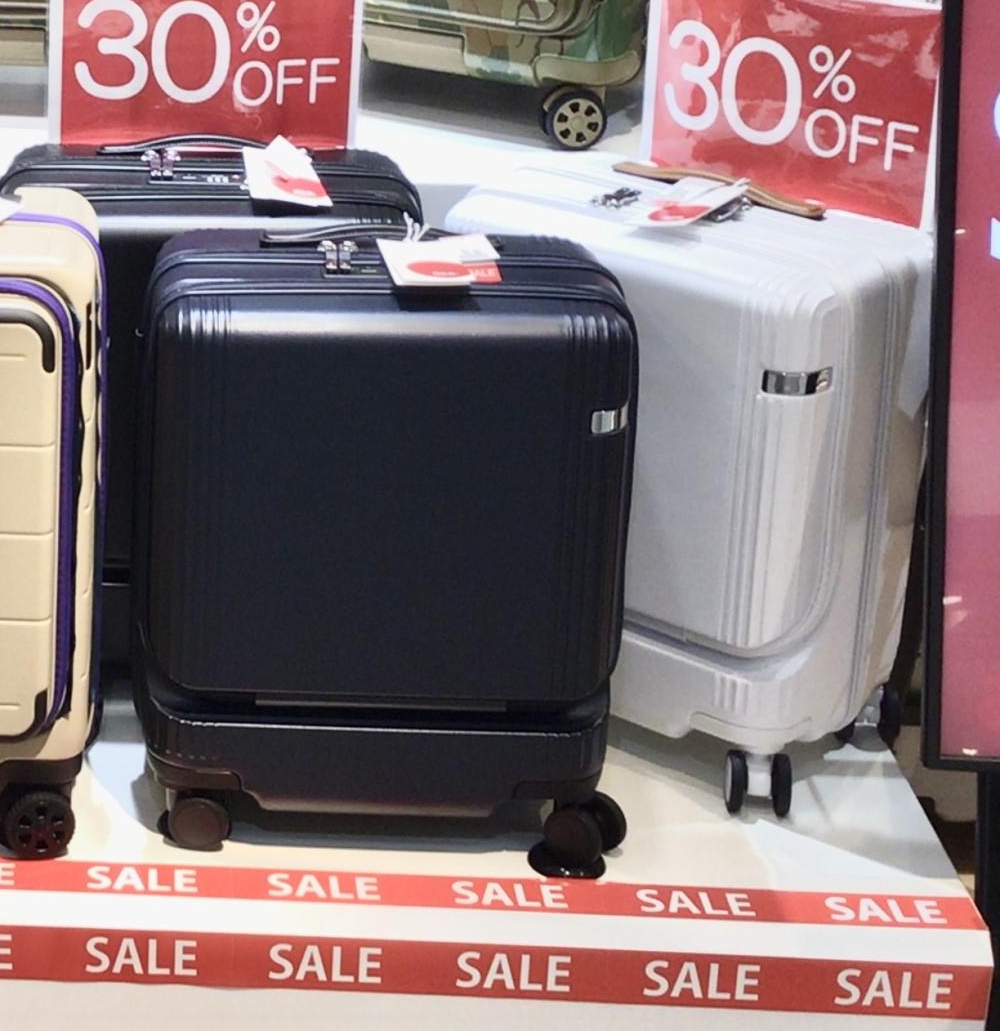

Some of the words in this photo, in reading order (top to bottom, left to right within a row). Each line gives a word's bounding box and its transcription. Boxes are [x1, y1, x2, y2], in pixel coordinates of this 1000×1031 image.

[233, 58, 340, 107] OFF
[805, 109, 919, 171] OFF
[86, 866, 198, 893] SALE
[268, 873, 381, 900] SALE
[452, 881, 569, 909] SALE
[637, 889, 756, 917] SALE
[825, 896, 948, 925] SALE
[86, 937, 197, 976] SALE
[268, 944, 382, 983] SALE
[456, 952, 571, 992] SALE
[643, 960, 761, 1000] SALE
[834, 969, 953, 1010] SALE
